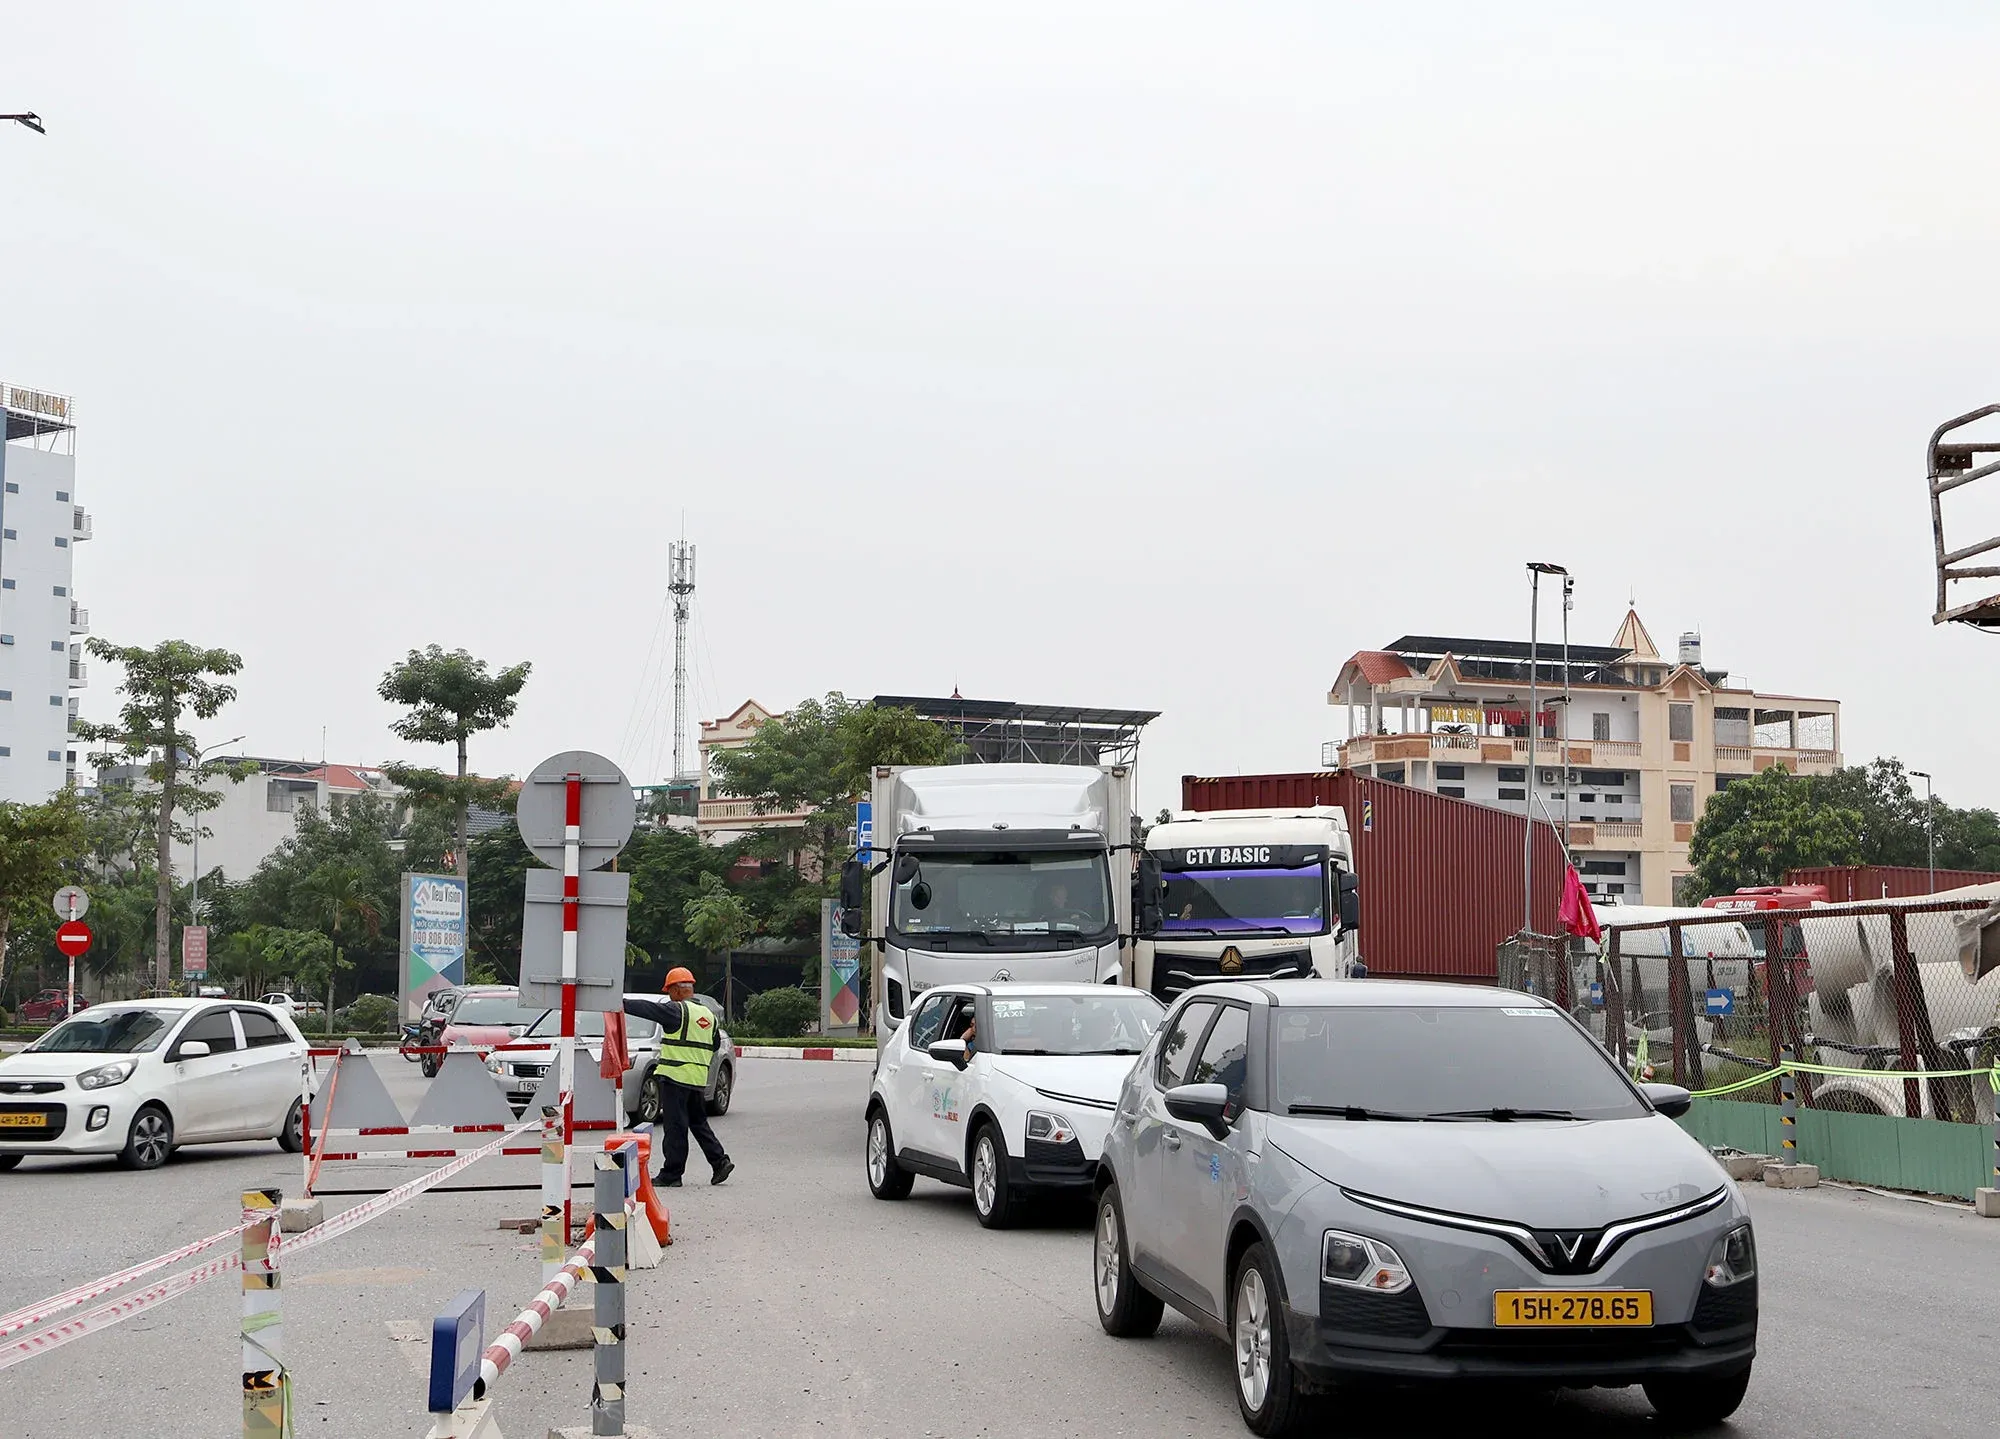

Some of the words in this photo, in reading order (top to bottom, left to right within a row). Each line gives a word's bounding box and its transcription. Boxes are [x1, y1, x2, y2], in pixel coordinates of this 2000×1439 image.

[11, 387, 66, 418] MINH
[1186, 848, 1216, 865] CTY
[1220, 846, 1271, 863] BASIC
[994, 1010, 1024, 1018] TAXI
[1511, 1297, 1639, 1321] 15H-278.65
